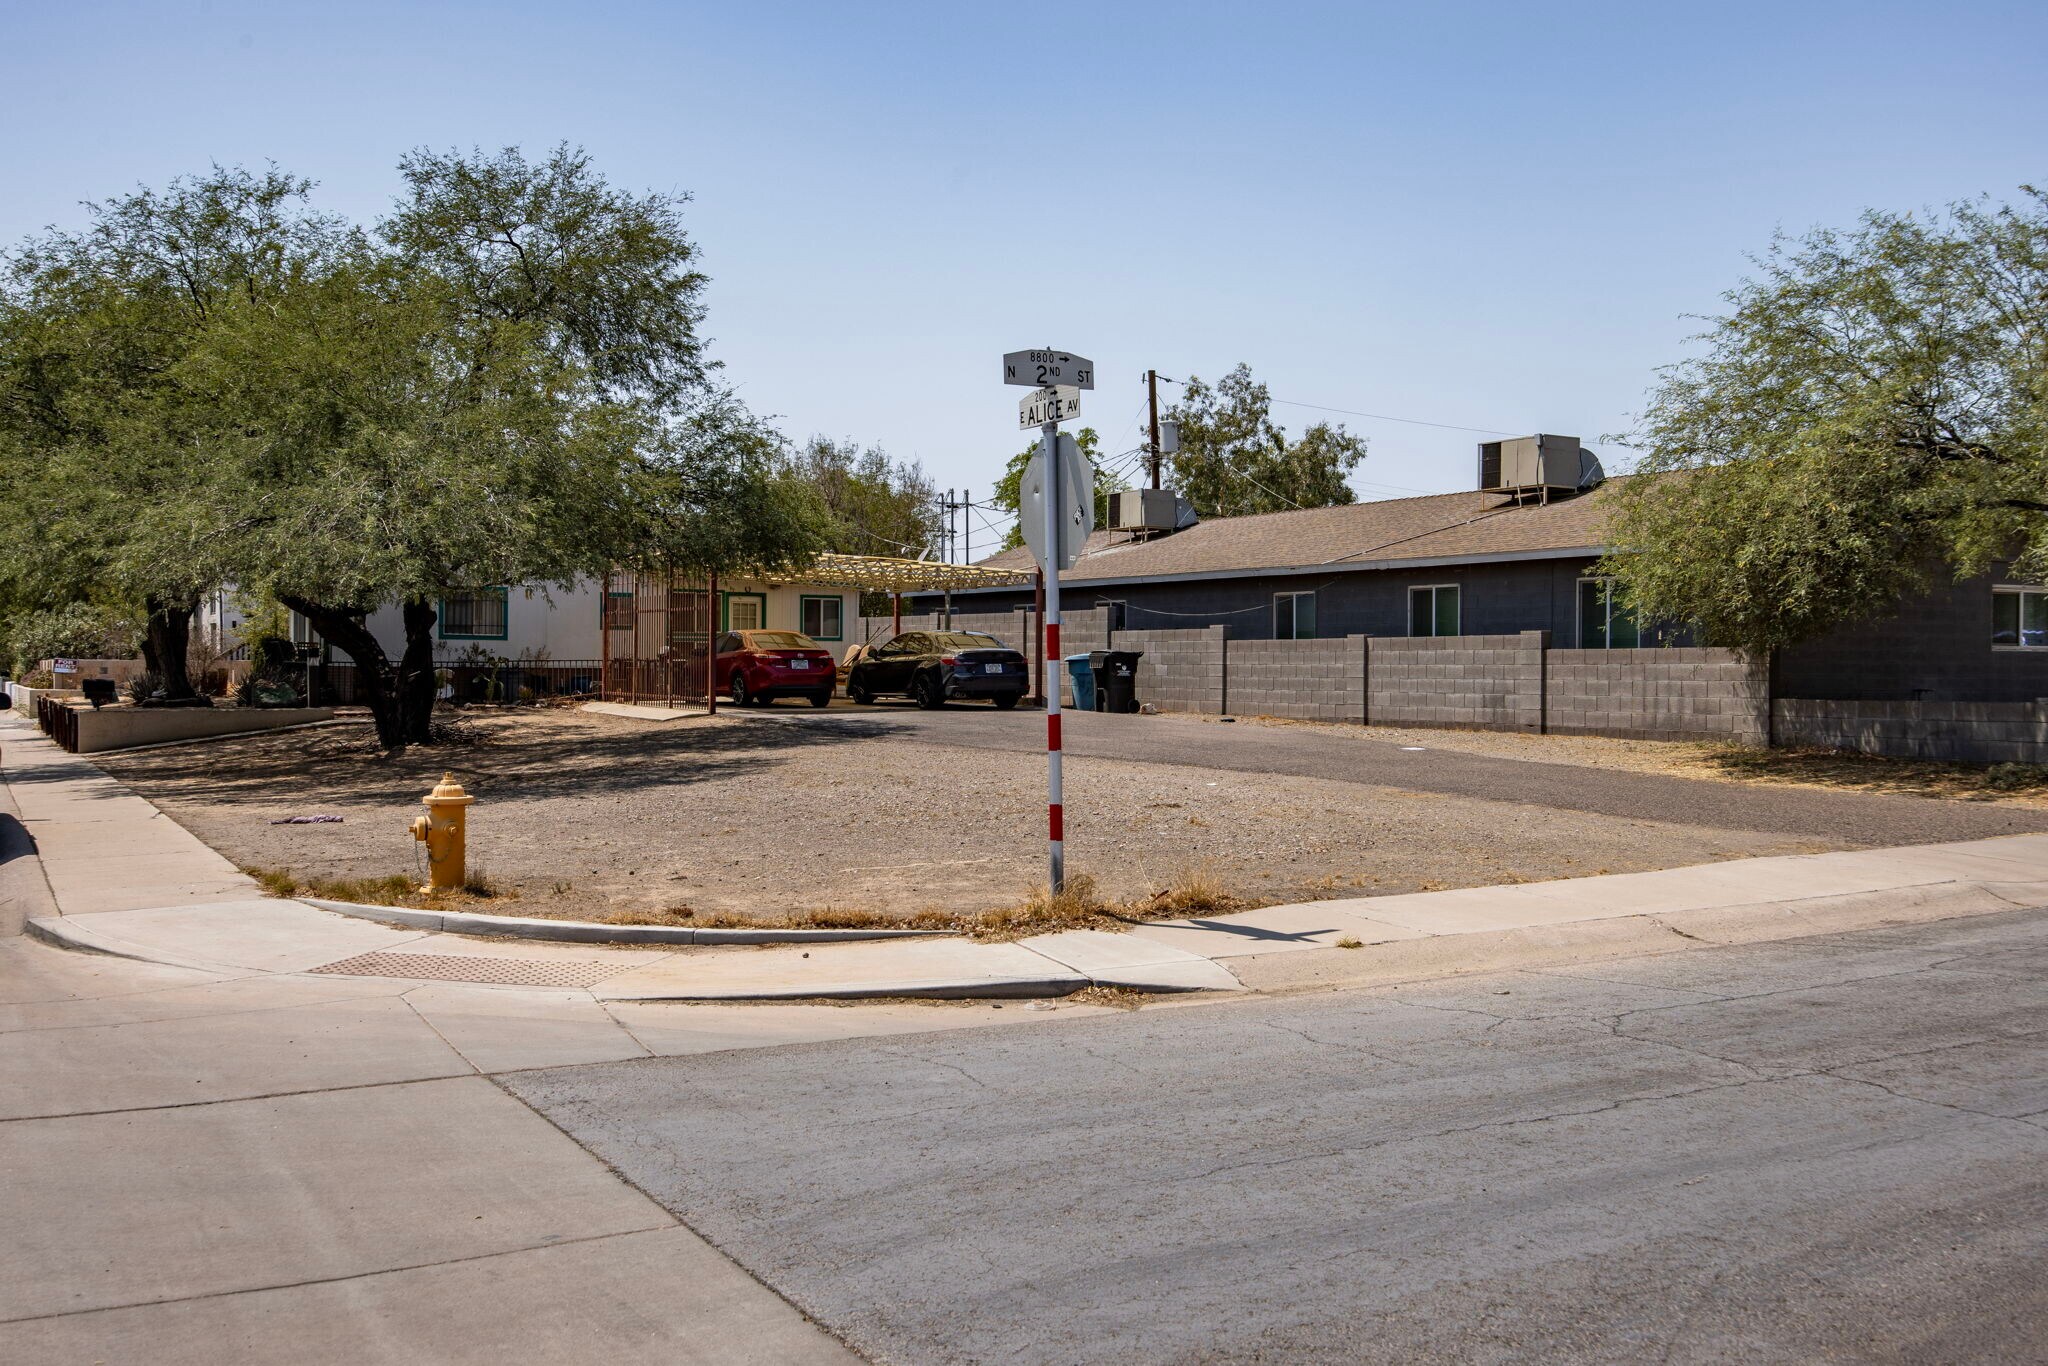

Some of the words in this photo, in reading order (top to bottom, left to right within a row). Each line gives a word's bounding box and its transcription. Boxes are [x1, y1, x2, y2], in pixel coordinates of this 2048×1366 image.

[1030, 352, 1054, 363] 8800
[1007, 365, 1016, 378] N
[1036, 364, 1061, 384] 2ND
[1077, 370, 1091, 383] ST
[1035, 390, 1047, 402] 200
[1020, 411, 1025, 424] E
[1027, 399, 1063, 426] ALICE
[1067, 398, 1079, 412] AV
